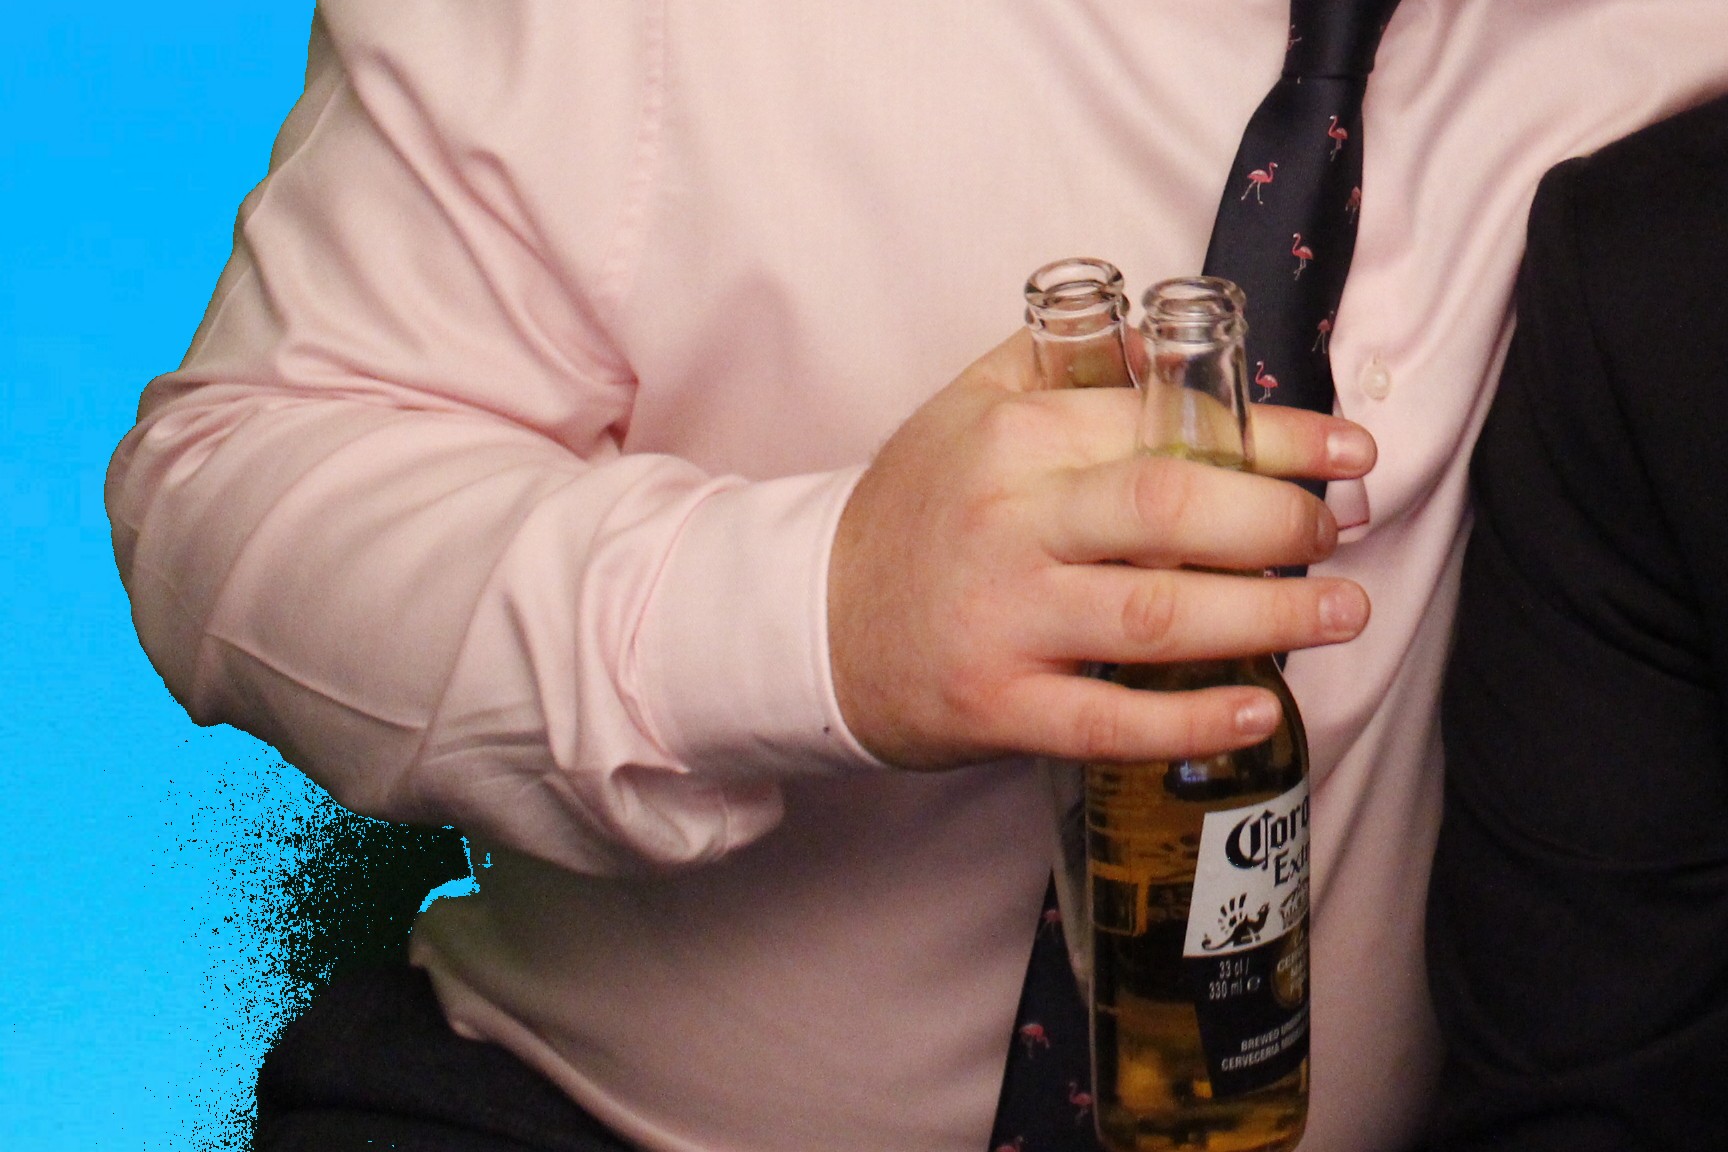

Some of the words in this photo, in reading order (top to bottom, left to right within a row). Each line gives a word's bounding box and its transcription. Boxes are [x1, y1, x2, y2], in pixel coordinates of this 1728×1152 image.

[1219, 959, 1231, 979] 33
[1208, 980, 1228, 1001] 330
[1230, 978, 1243, 997] ml
[1240, 1027, 1280, 1052] BREWED
